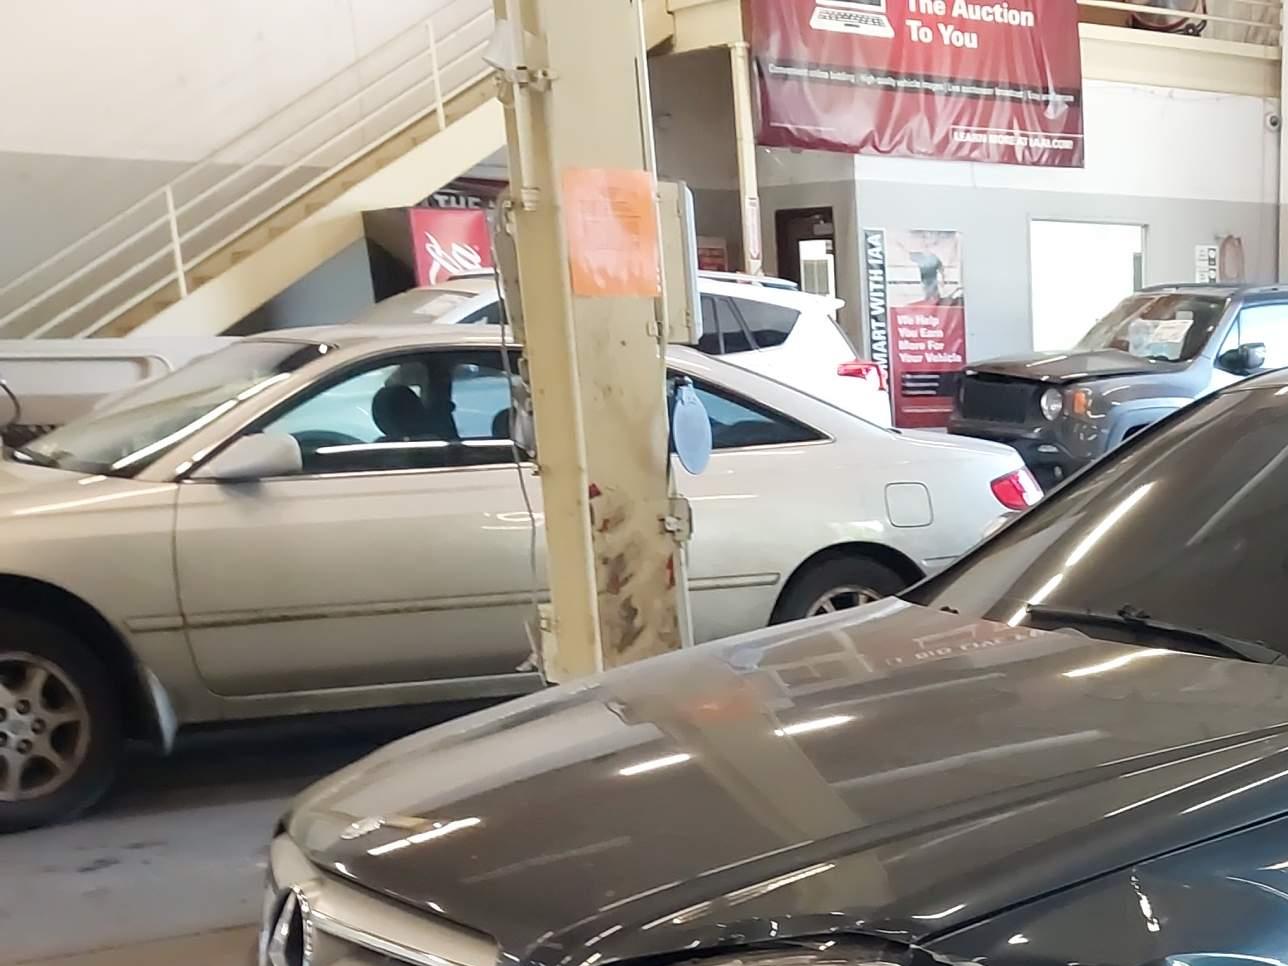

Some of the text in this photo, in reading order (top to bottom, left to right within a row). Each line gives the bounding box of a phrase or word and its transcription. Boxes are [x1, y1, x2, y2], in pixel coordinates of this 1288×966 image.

[907, 0, 1035, 27] The Auction
[905, 19, 978, 48] To You
[866, 233, 888, 374] MART WITH IAA
[915, 315, 939, 327] Help
[897, 328, 944, 338] You Earn
[898, 340, 944, 350] More For
[898, 352, 962, 363] Your Vehicle
